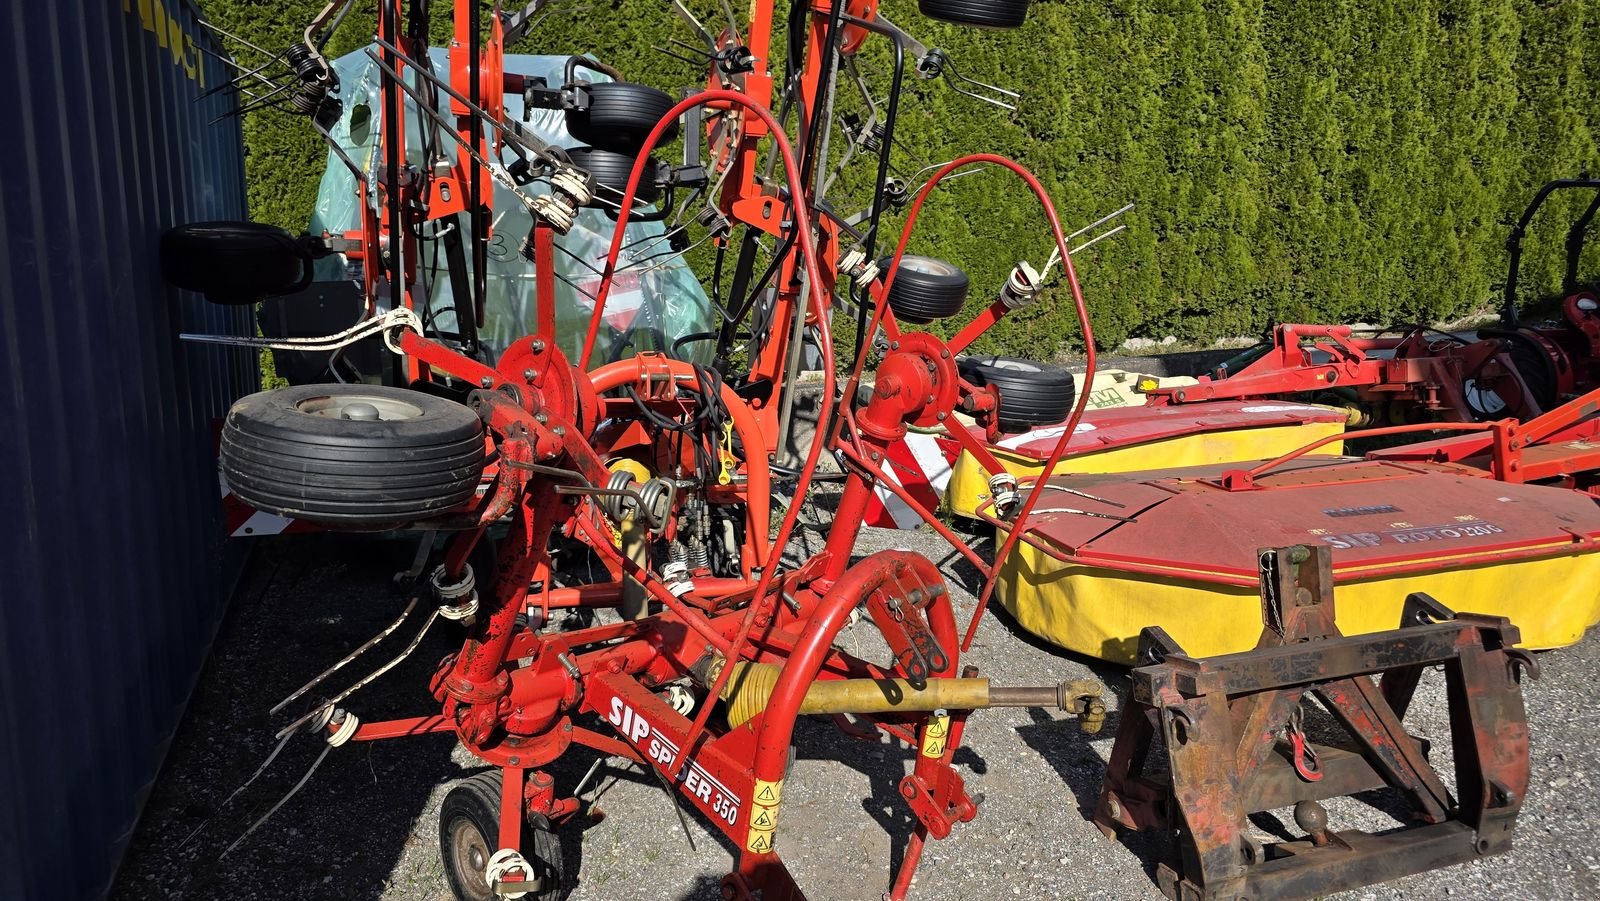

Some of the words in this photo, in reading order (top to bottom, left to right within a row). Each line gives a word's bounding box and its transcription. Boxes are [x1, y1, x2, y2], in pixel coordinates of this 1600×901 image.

[1321, 531, 1382, 549] SIP
[1391, 528, 1463, 545] ROTO
[608, 696, 650, 744] SIP
[712, 793, 738, 826] 350
